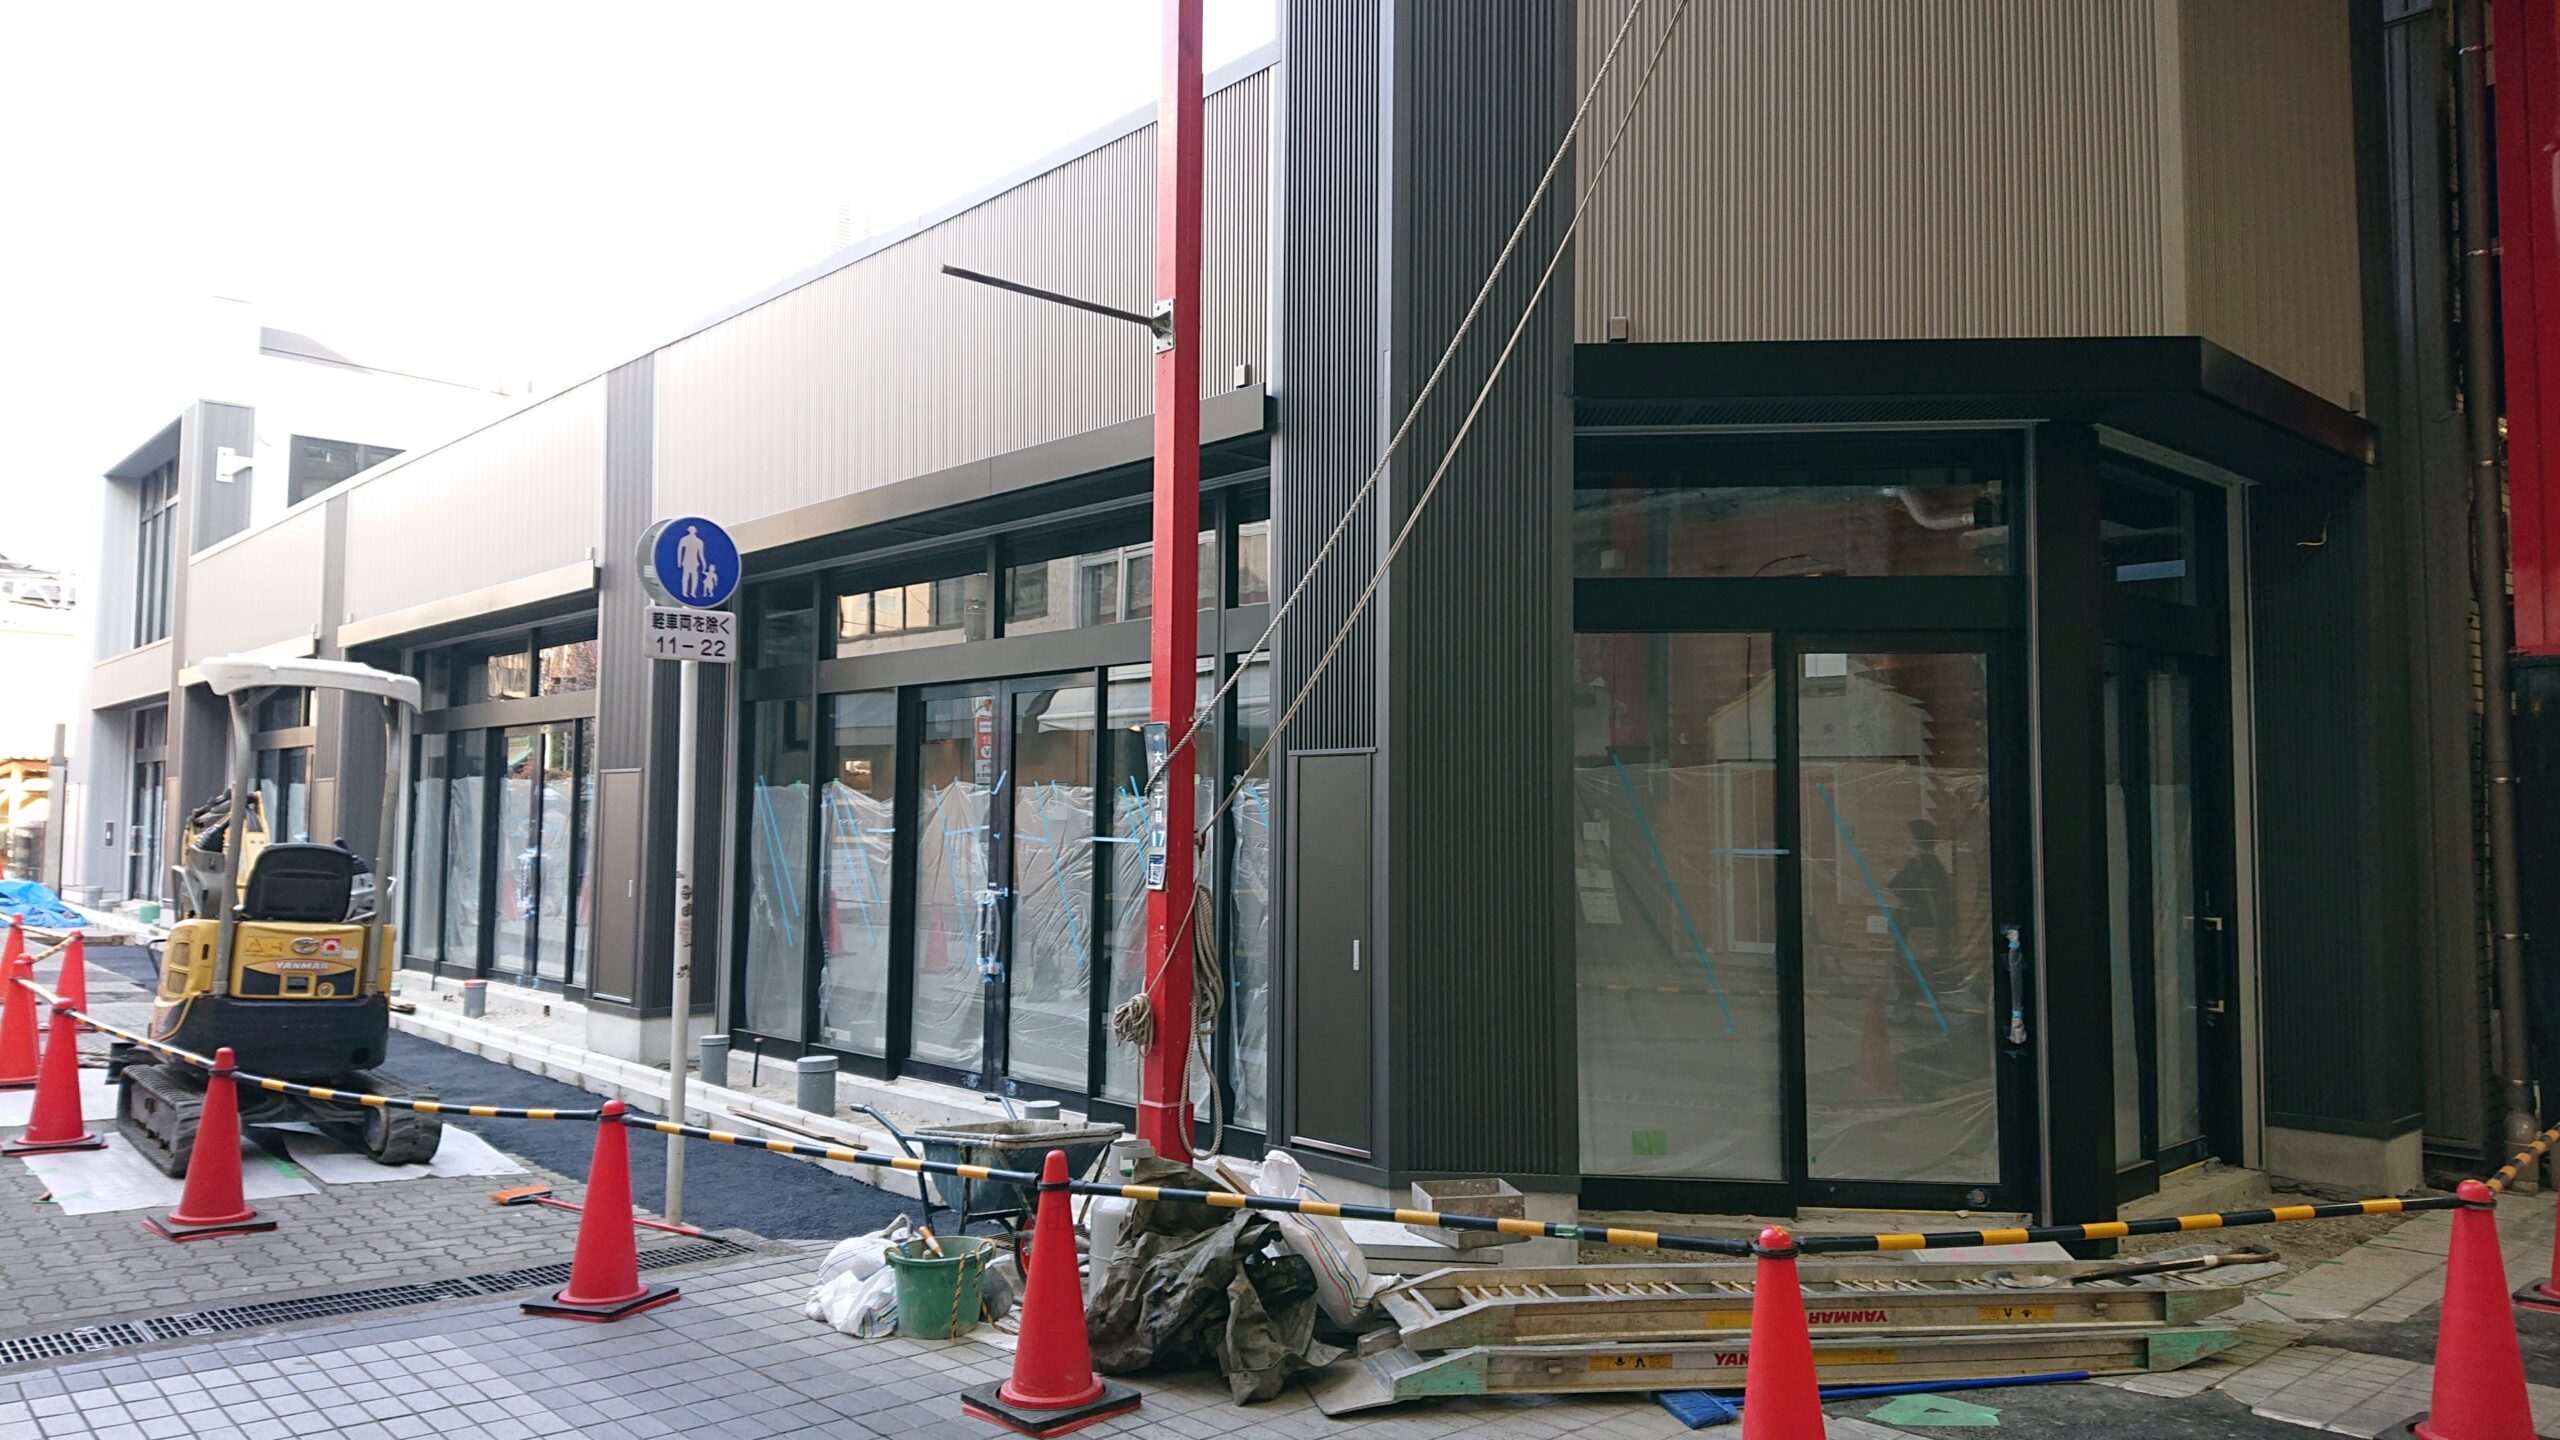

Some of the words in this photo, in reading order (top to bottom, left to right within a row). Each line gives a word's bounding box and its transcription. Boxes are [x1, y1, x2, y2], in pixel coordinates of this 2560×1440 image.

[652, 612, 730, 635] 軽車両を除く
[1153, 750, 1164, 823] 大二丁目
[1151, 830, 1166, 847] 17
[275, 961, 329, 970] YANMAR
[1808, 1310, 1888, 1325] YANMAR
